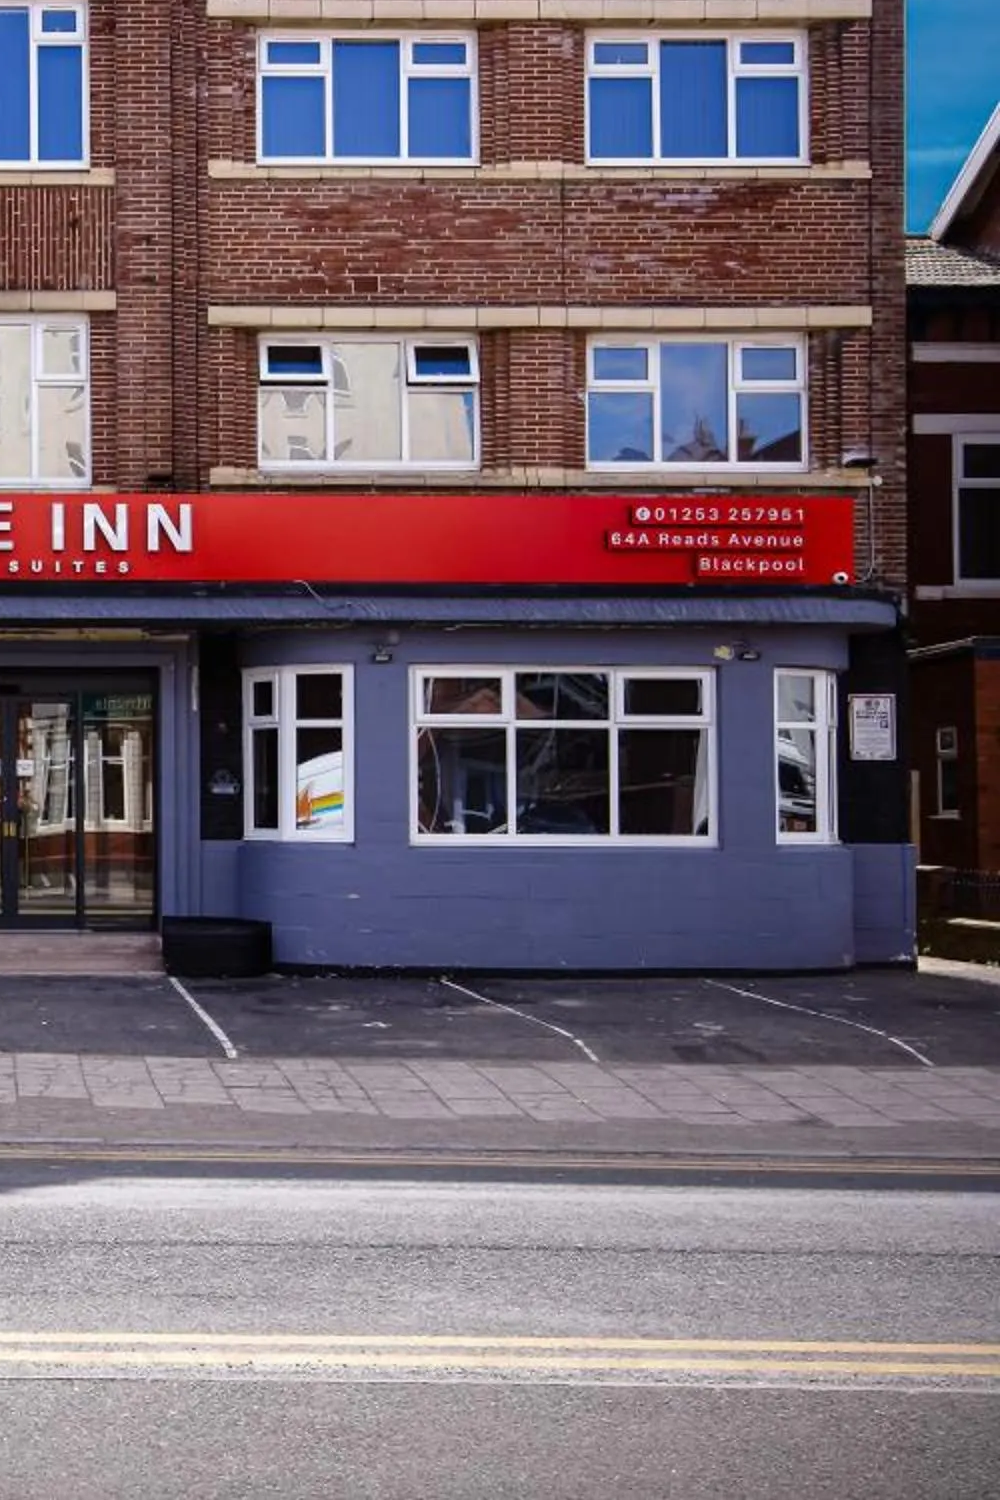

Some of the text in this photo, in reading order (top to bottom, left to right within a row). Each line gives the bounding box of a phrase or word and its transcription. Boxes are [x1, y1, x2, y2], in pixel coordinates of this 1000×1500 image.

[50, 502, 193, 551] INN
[611, 531, 804, 546] 64A Reads Avenue
[8, 559, 130, 573] SUITES
[699, 556, 804, 574] Blackpool
